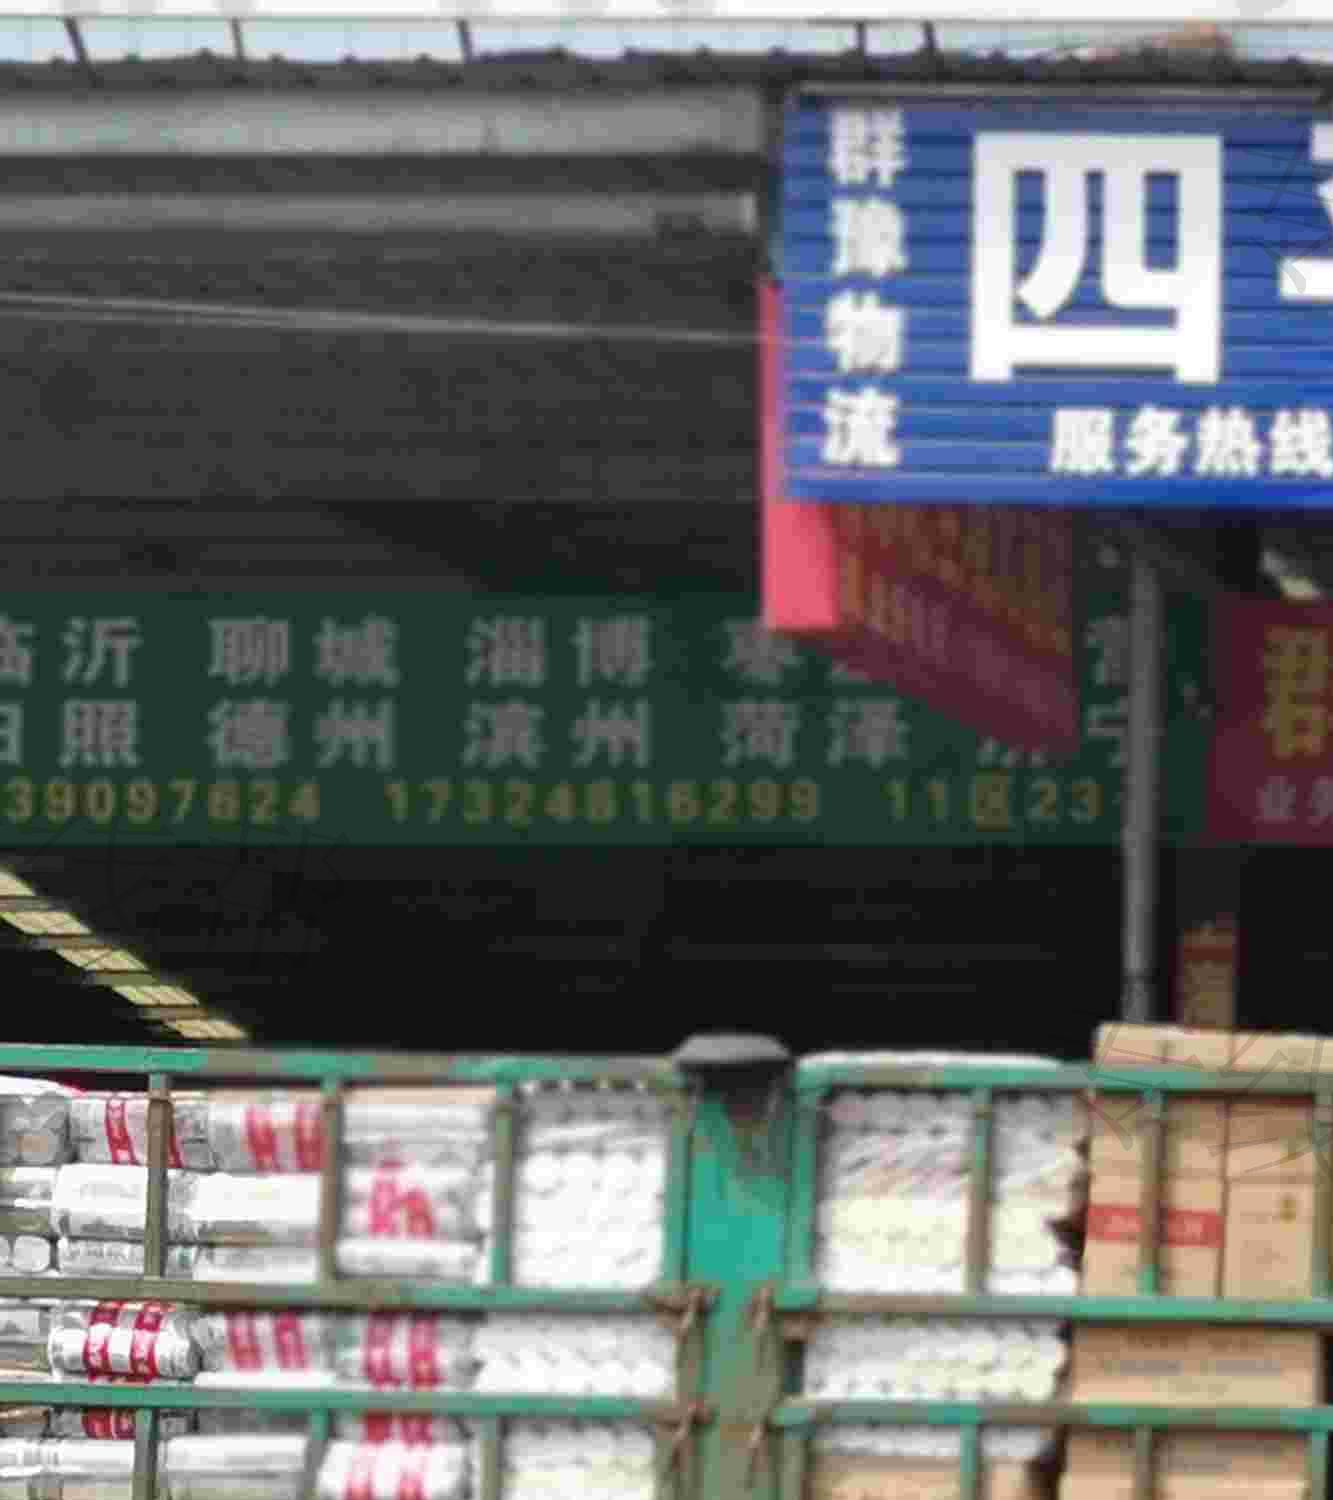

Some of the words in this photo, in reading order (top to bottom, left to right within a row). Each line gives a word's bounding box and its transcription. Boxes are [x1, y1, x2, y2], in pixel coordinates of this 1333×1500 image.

[207, 609, 403, 688] 聊城
[206, 696, 399, 772] 德州
[461, 696, 653, 768] 滨州
